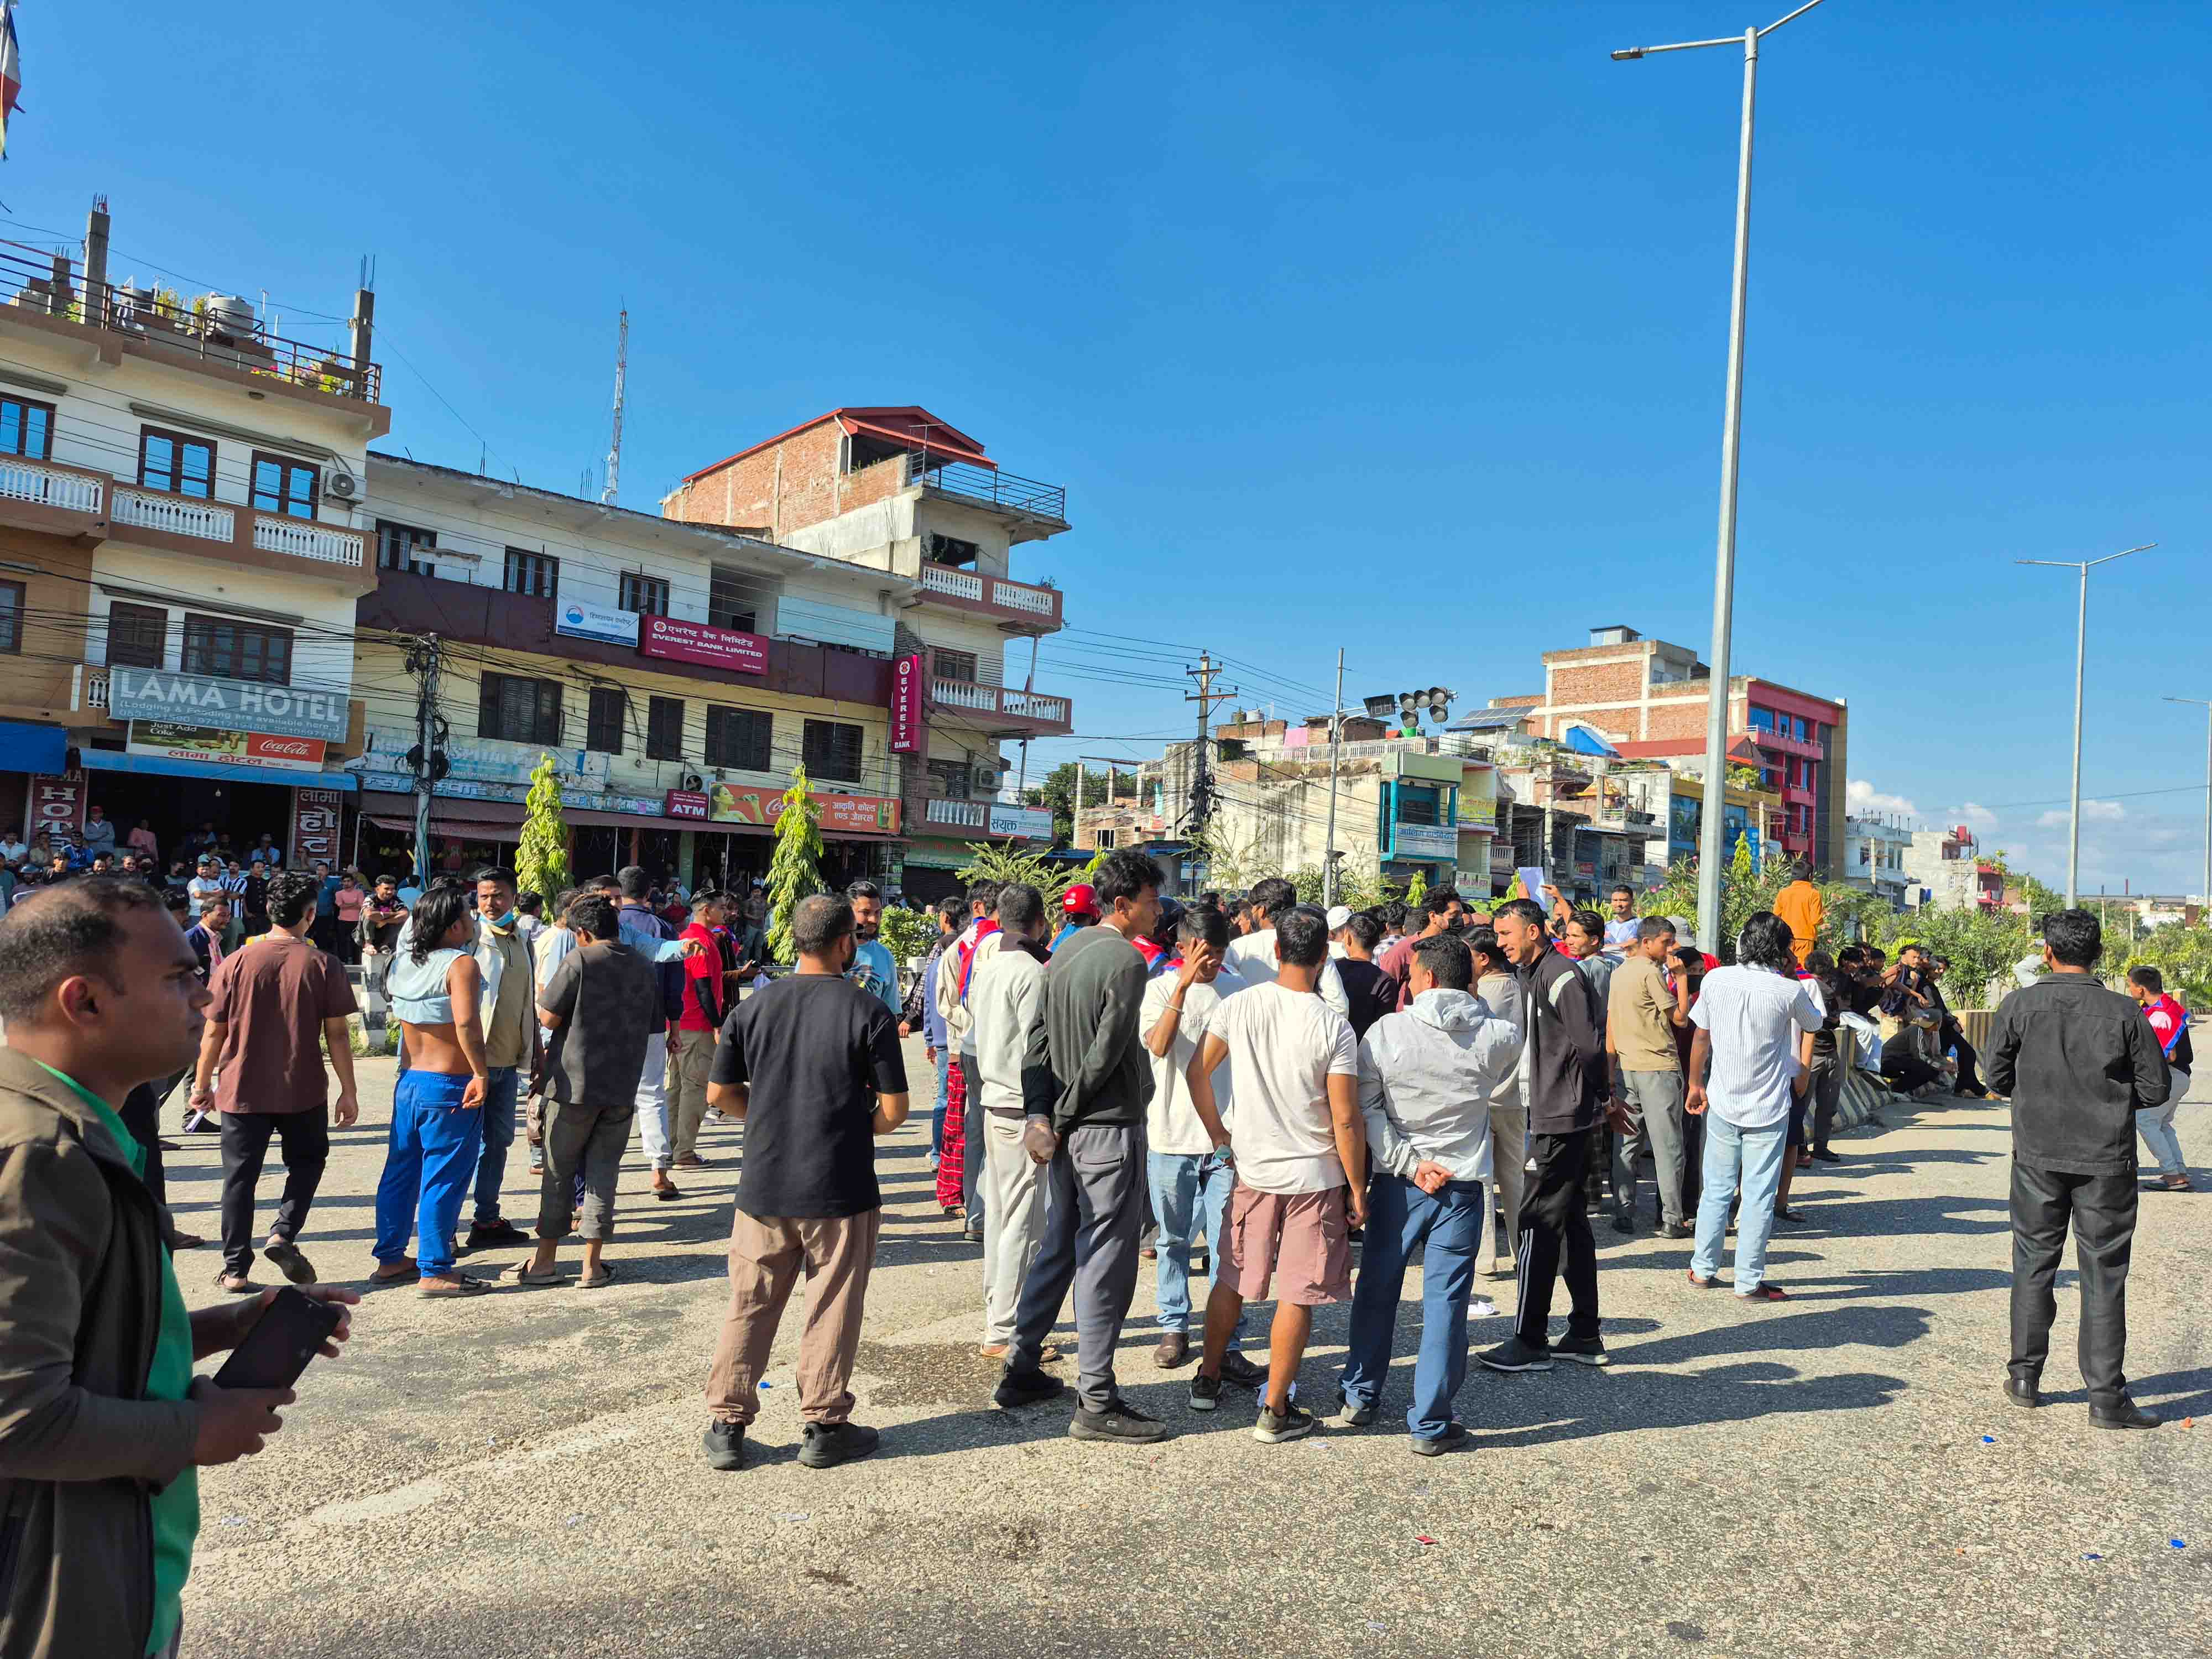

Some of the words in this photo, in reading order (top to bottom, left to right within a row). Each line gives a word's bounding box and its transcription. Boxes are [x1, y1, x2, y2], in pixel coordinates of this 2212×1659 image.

[652, 633, 695, 646] EVEREST
[697, 641, 724, 651] BANK
[725, 646, 763, 658] LIMITED
[721, 634, 754, 648] लिमिटेड
[119, 671, 226, 708] LAMA
[239, 684, 340, 722] HOTEL
[899, 677, 908, 740] EVEREST
[256, 716, 302, 727] available
[894, 740, 911, 749] BANK
[168, 750, 210, 760] लामा
[217, 753, 263, 765] होटल
[300, 789, 337, 803] लामा
[672, 804, 705, 817] ATM
[831, 800, 855, 812] आकृति
[858, 801, 876, 812] कोल्ड
[834, 812, 850, 820] एण्ड
[850, 811, 874, 823] जेनरल
[990, 814, 1018, 833] संयुक्त
